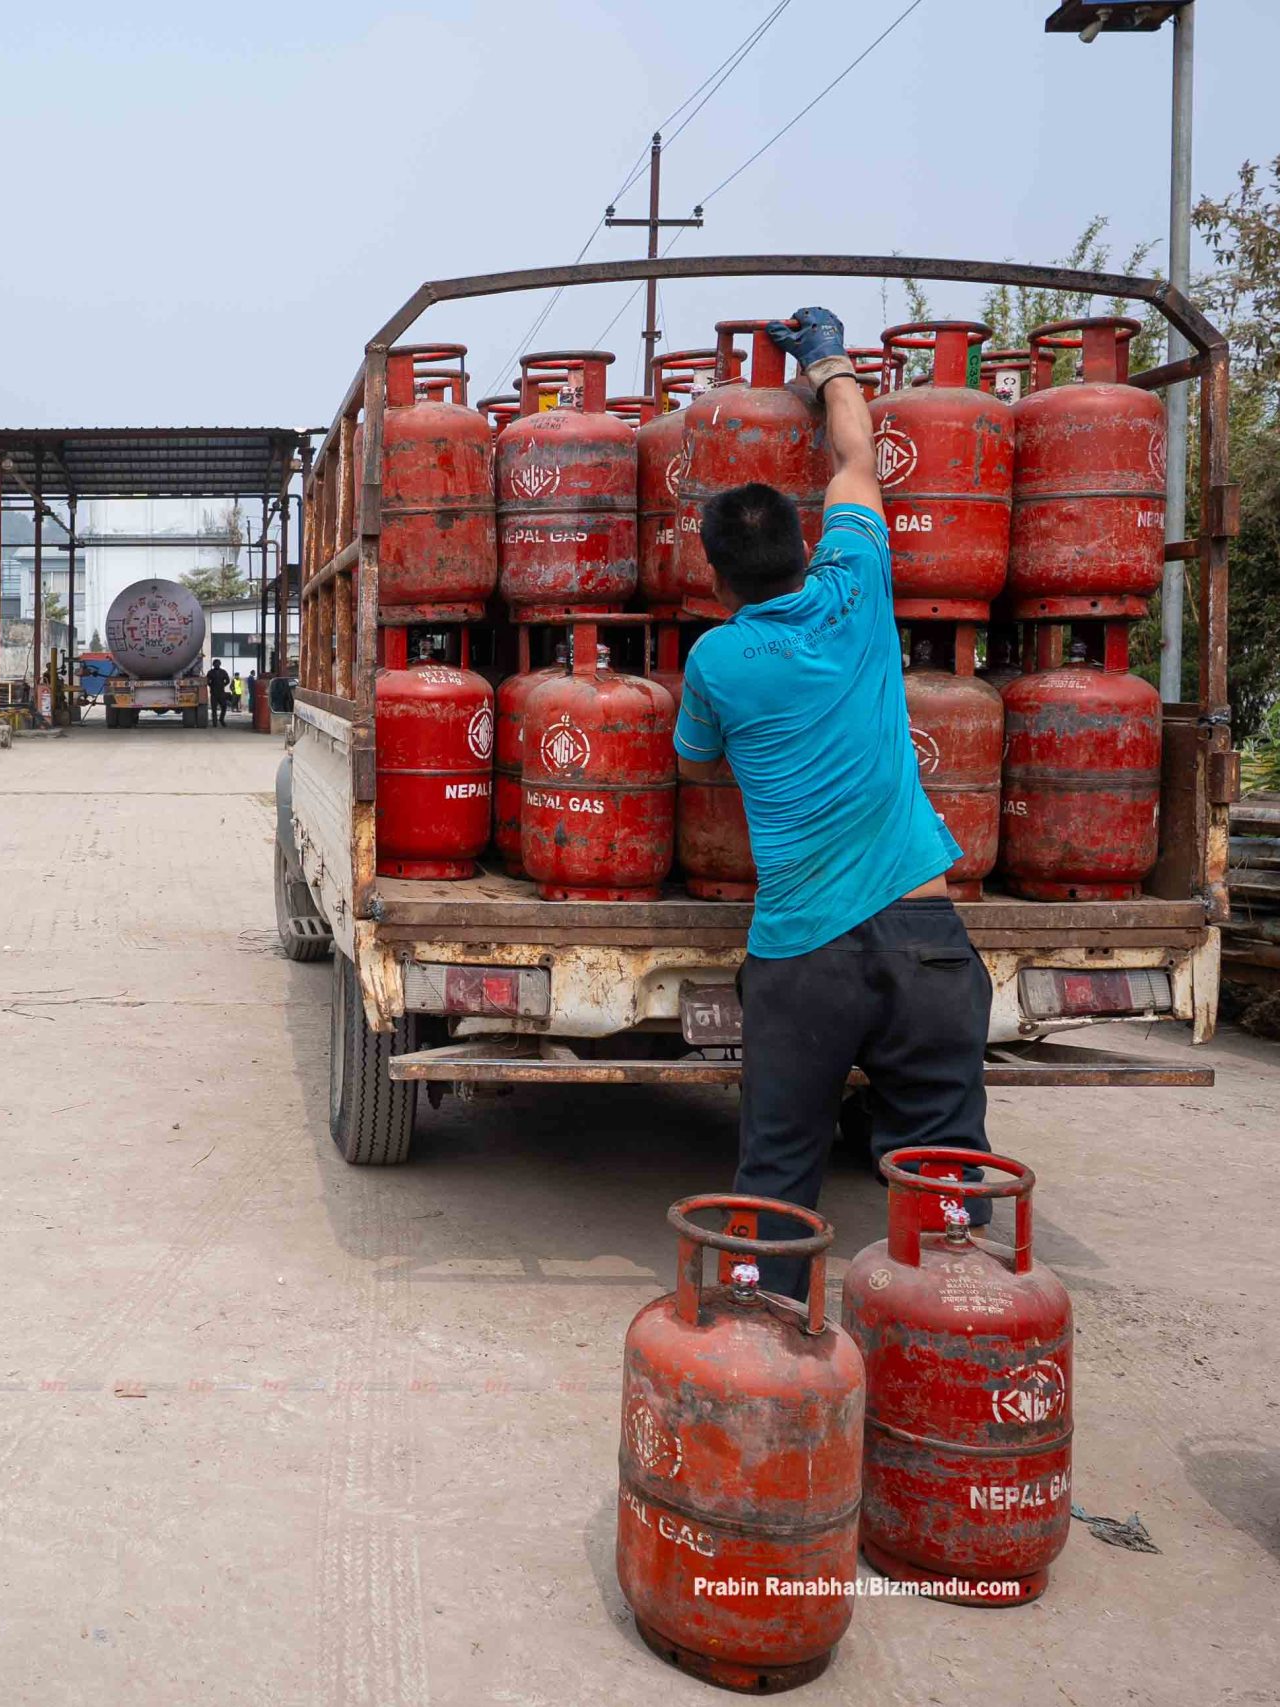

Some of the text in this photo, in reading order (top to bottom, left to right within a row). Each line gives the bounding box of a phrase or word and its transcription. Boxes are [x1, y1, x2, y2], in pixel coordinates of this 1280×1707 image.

[895, 514, 933, 532] GAS
[418, 671, 445, 679] NETT
[425, 677, 447, 685] 14.2
[445, 783, 487, 799] NEPAL
[527, 790, 604, 814] NEPAL GAS
[970, 1482, 1046, 1511] NEPAL
